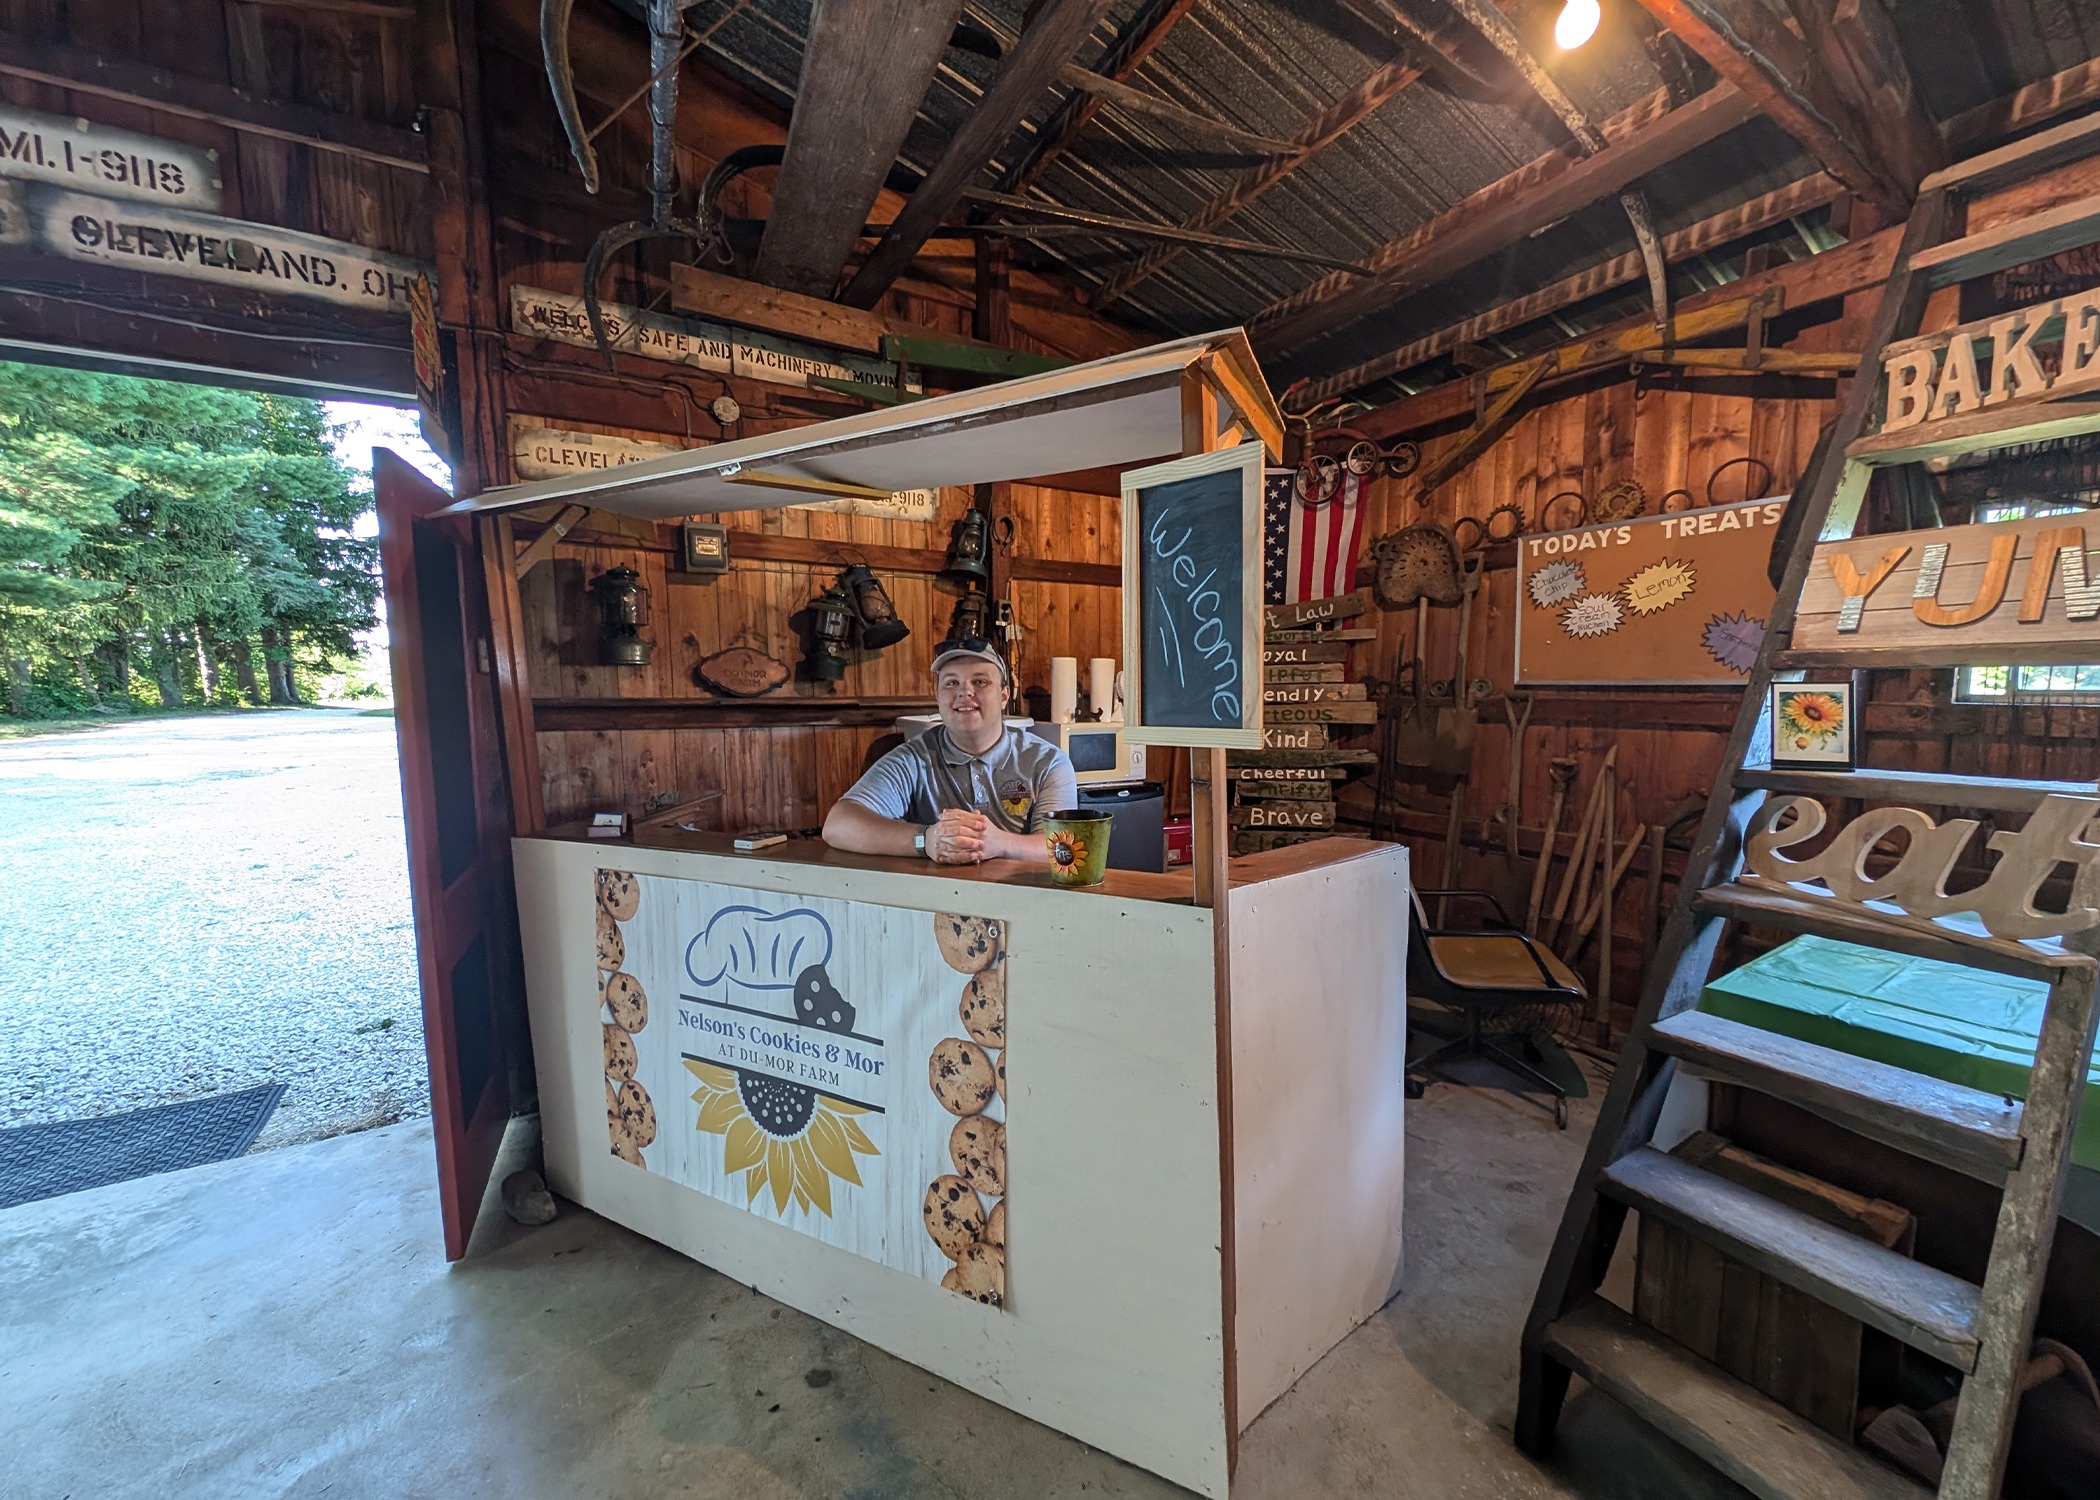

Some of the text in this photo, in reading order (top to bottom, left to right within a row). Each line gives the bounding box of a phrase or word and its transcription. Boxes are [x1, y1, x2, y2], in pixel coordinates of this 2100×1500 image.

[639, 324, 688, 353] SAFE
[697, 339, 731, 360] AND
[740, 345, 832, 379] MACHINERY
[853, 369, 903, 389] MOVIN
[1529, 503, 1781, 557] TODAY'S TREATS
[1634, 573, 1687, 601] Lemon
[1149, 507, 1242, 722] Welcome
[1295, 603, 1334, 622] Law
[1263, 648, 1306, 663] oyal
[1263, 688, 1325, 702] endly
[1263, 728, 1309, 748] Kind
[1240, 768, 1325, 780] Cheerful
[1250, 807, 1323, 826] Brave
[1742, 793, 2100, 943] eat
[678, 1009, 885, 1076] Nelson's Cookies & Mor
[718, 1043, 840, 1086] AT DU-MOR FARM
